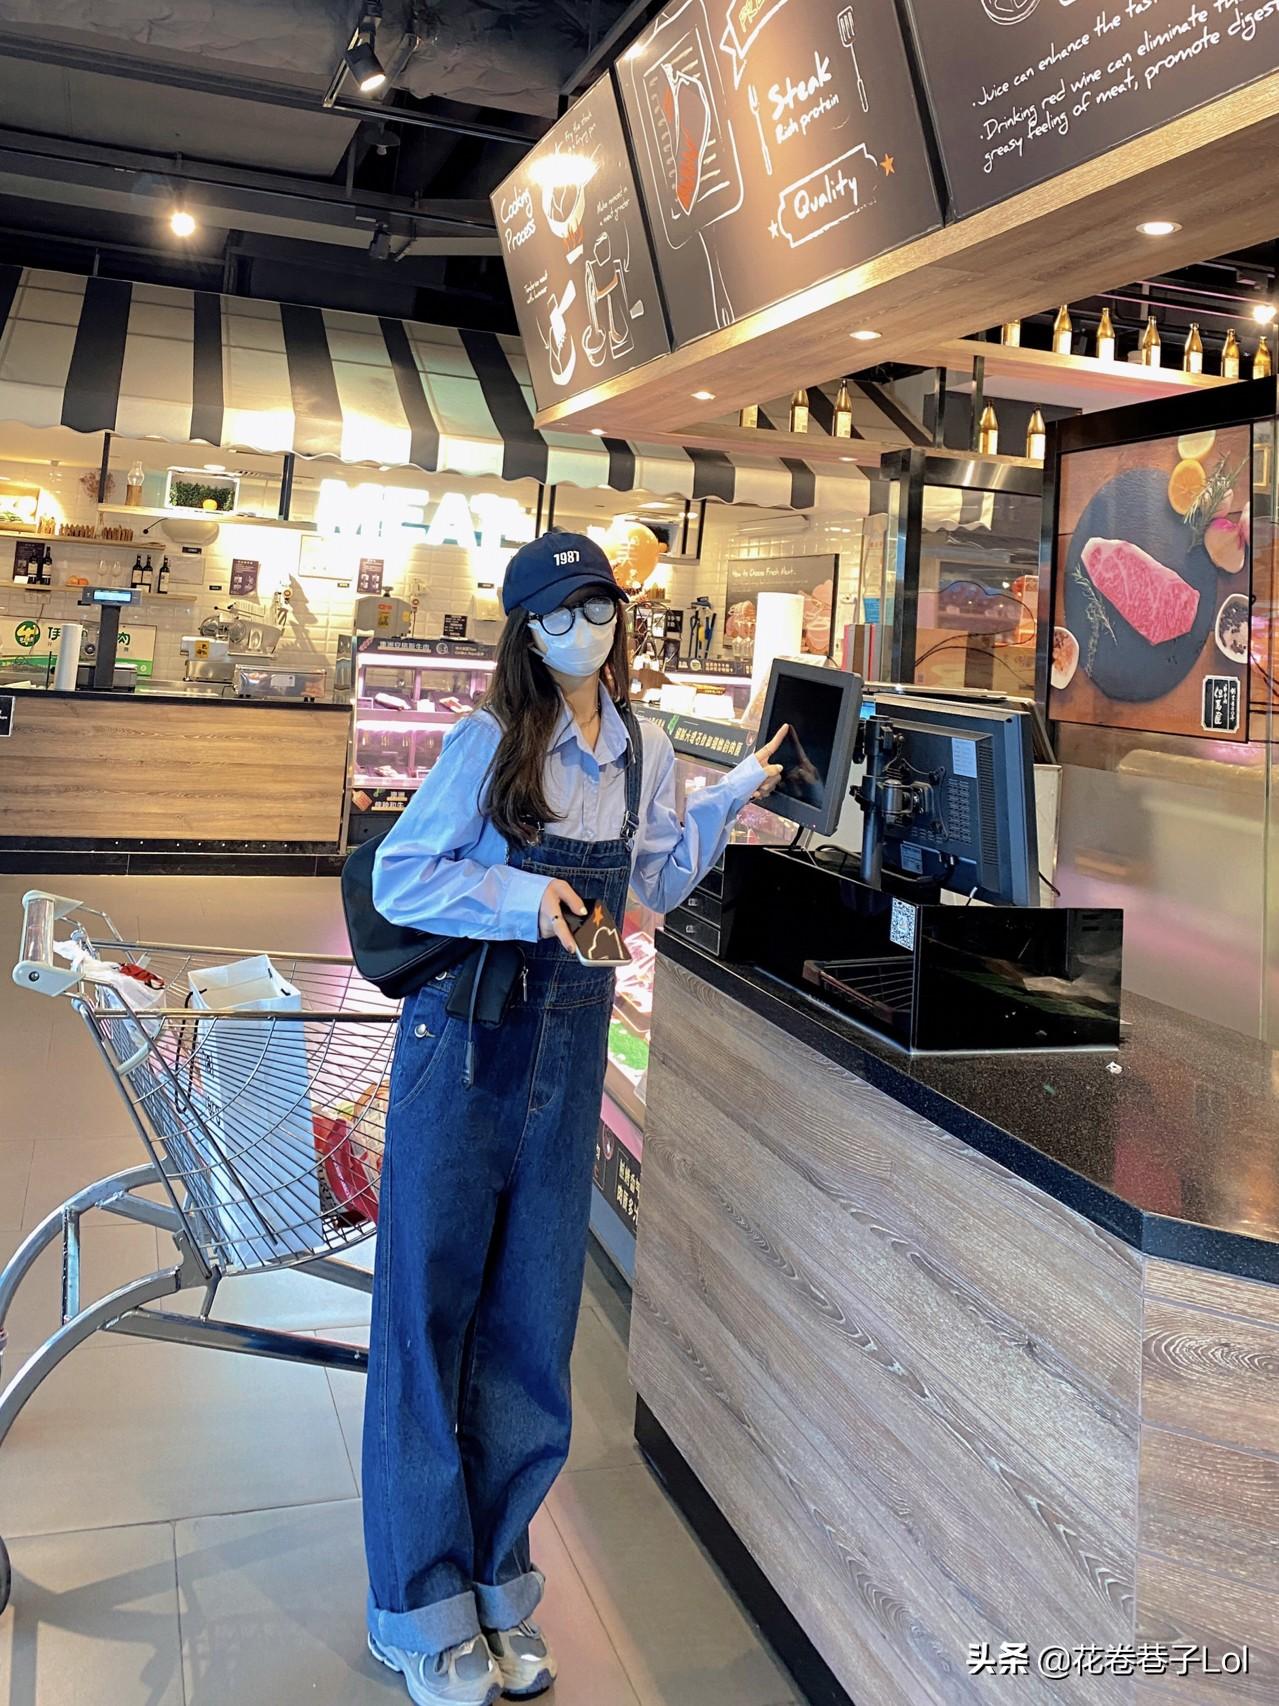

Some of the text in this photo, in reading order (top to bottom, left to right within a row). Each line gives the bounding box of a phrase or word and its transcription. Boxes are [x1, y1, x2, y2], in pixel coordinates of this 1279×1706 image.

[978, 0, 1157, 106] Juice can enhance the tas
[983, 105, 1037, 140] Drinking
[1041, 78, 1065, 110] red
[1070, 69, 1101, 92] wine
[1107, 52, 1132, 73] can
[1136, 4, 1209, 56] eliminate
[768, 51, 832, 121] Steak
[983, 137, 1023, 173] greasy
[1027, 110, 1068, 139] feeling
[1072, 91, 1091, 116] of
[1095, 67, 1138, 104] meat,
[1144, 26, 1221, 90] promote
[775, 94, 840, 144] Rich protein
[501, 186, 533, 224] Cooking
[793, 169, 858, 219] Quality
[505, 218, 536, 253] Process
[553, 550, 580, 566] 1987
